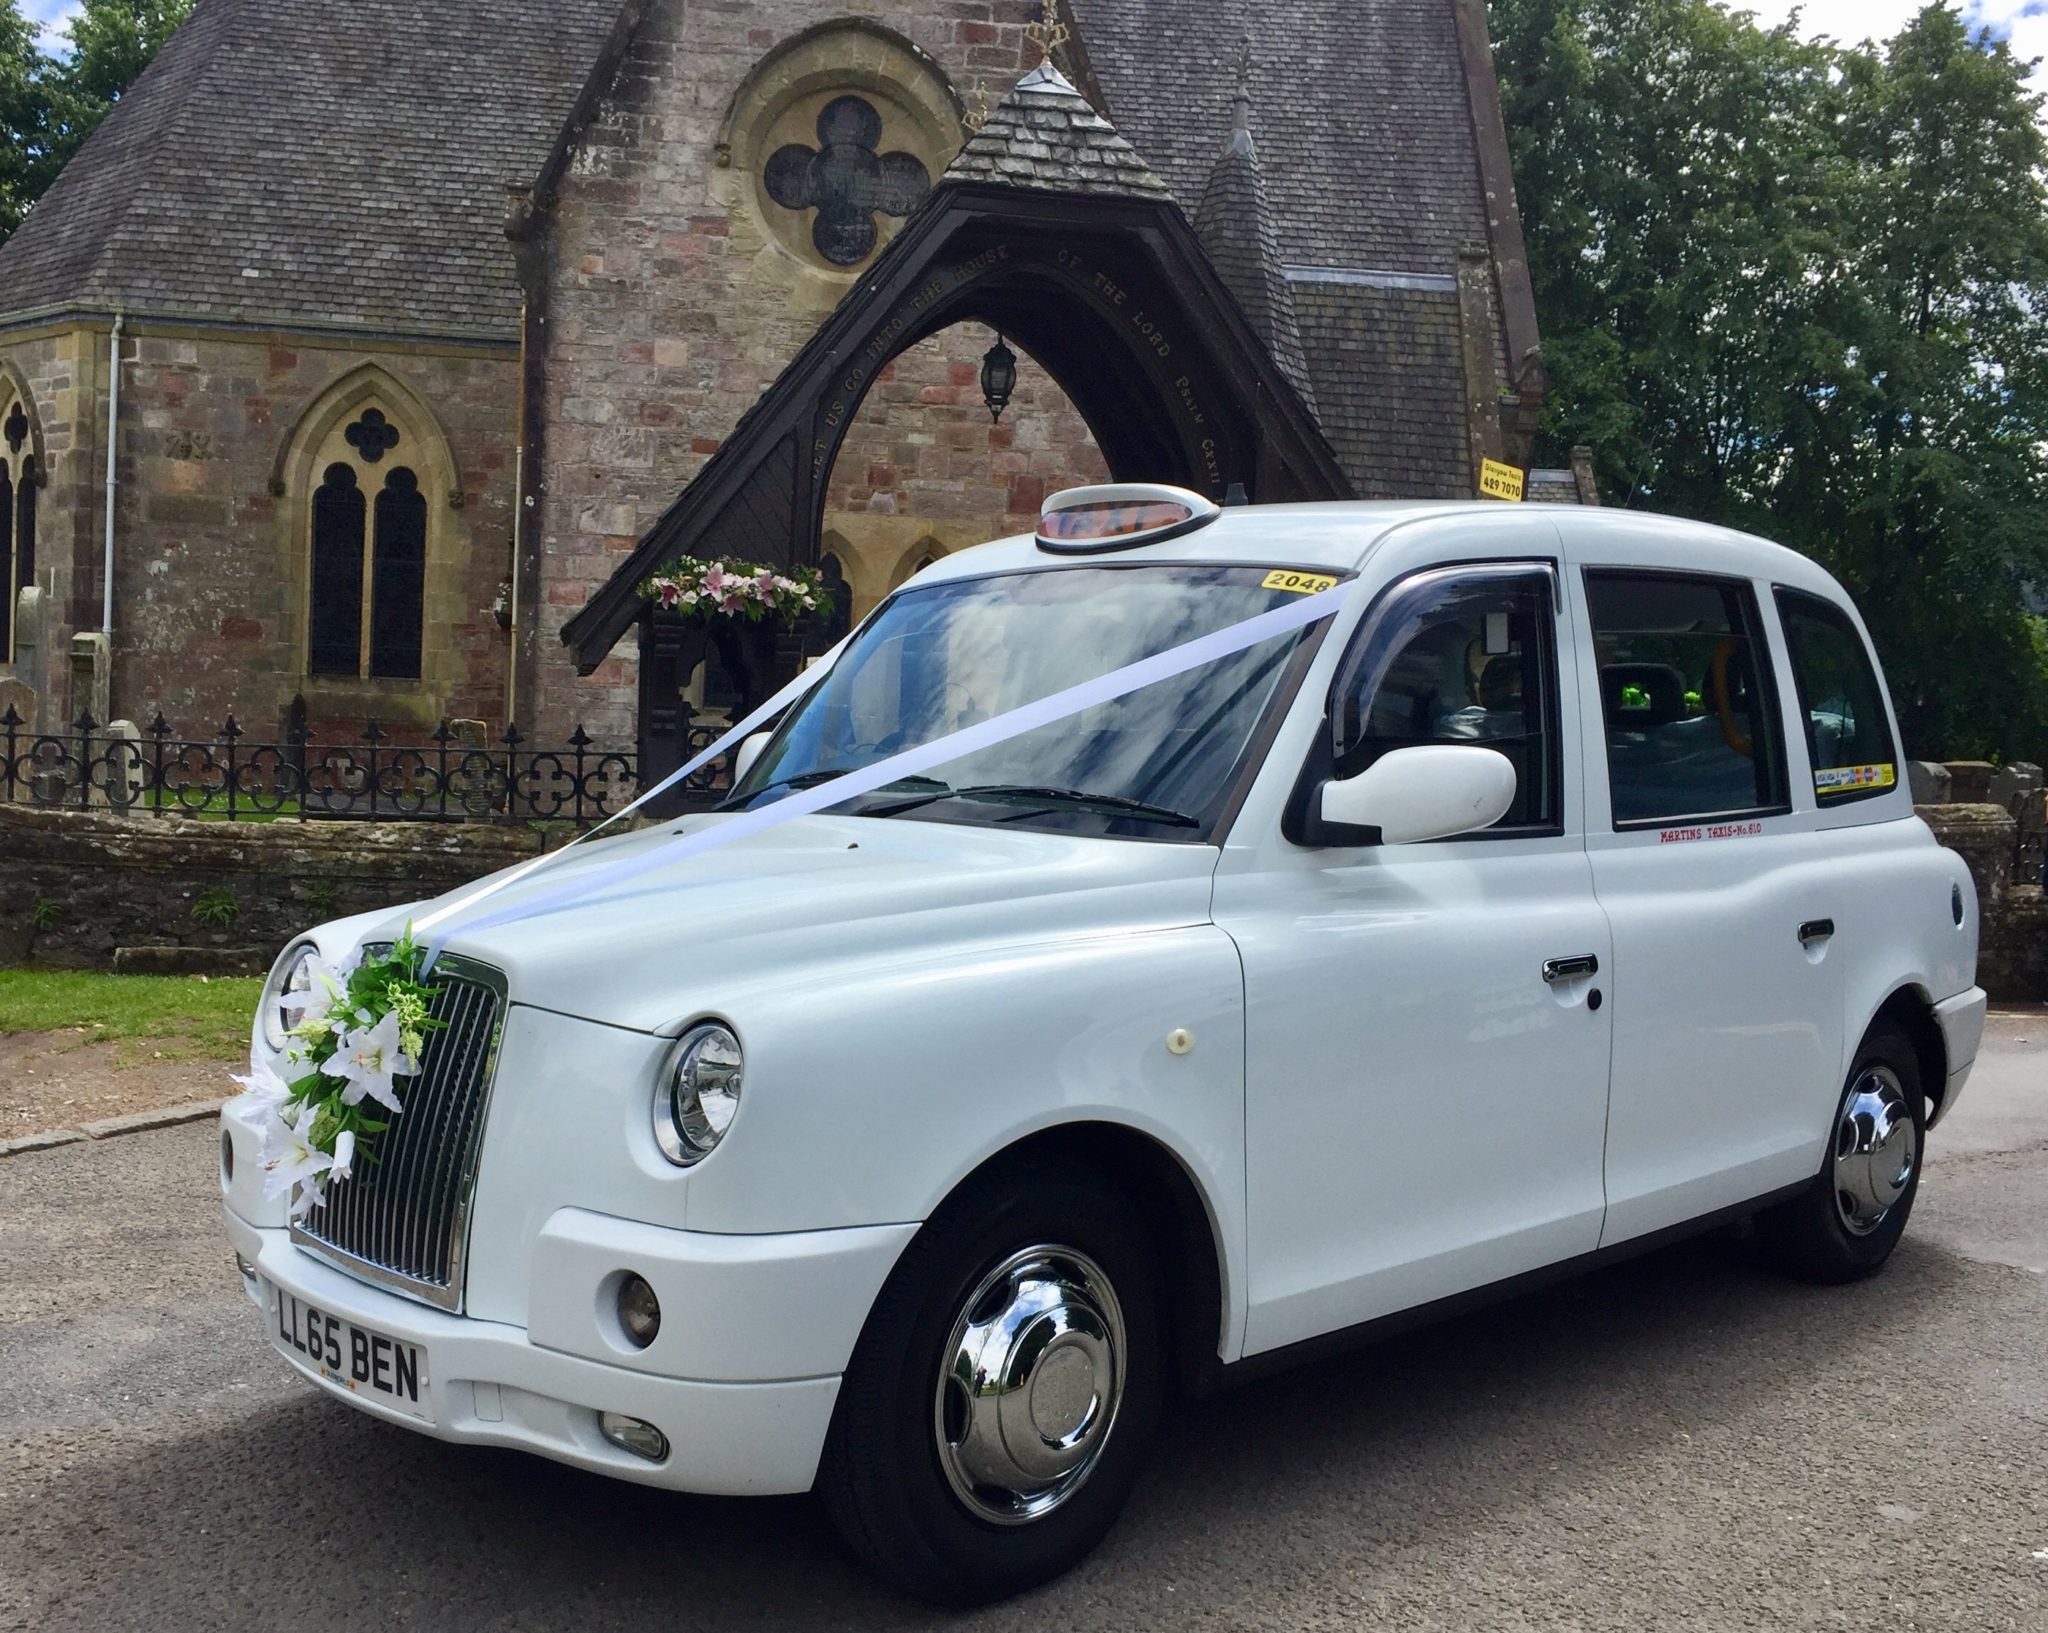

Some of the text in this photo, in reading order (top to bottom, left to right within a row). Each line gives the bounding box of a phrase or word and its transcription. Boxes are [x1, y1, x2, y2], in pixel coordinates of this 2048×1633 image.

[811, 438, 826, 480] LET
[823, 400, 845, 428] US
[844, 368, 864, 391] GO
[865, 318, 902, 361] INTO
[910, 280, 944, 312] THE
[951, 244, 1008, 281] HOUSE
[1057, 249, 1082, 267] OF
[1094, 271, 1127, 304] THE
[1132, 312, 1170, 357] LORD
[1484, 476, 1521, 497] 429 7070
[1053, 503, 1147, 536] TAXI
[1269, 574, 1331, 593] 2048
[1660, 829, 1702, 843] MARTINS
[278, 1289, 418, 1402] LL65 BEN
